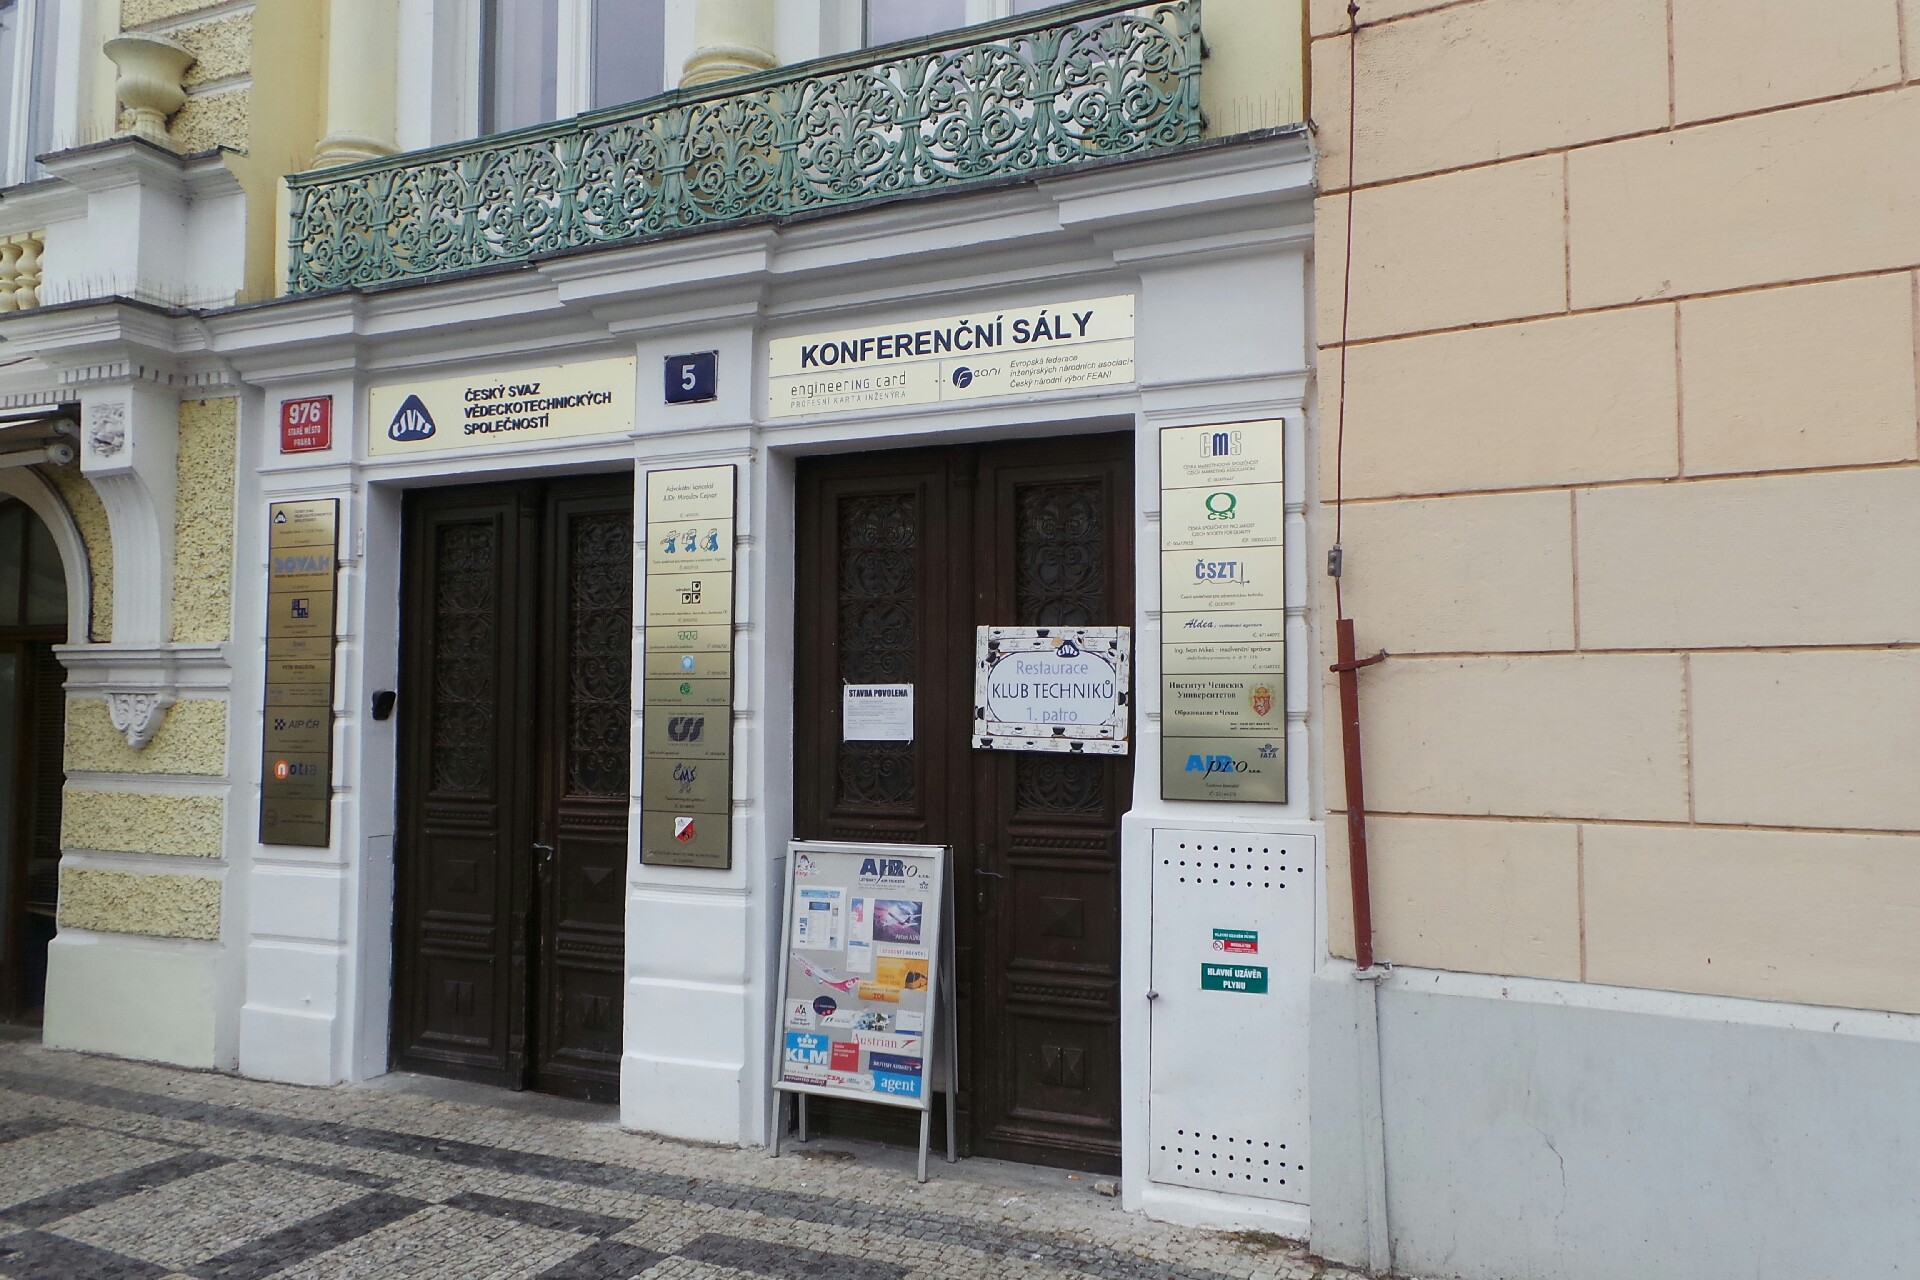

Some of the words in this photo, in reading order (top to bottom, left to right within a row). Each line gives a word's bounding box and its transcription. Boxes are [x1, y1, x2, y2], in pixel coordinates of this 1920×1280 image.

[802, 314, 1003, 368] KONFERENČNÍ
[1012, 310, 1094, 344] SÁLY
[682, 364, 695, 390] 5
[876, 371, 906, 388] card
[464, 386, 505, 402] ČESKÝ
[508, 383, 540, 398] SVAZ
[833, 395, 862, 404] KARTA
[865, 390, 906, 401] INŽENÝRA
[464, 391, 612, 419] VĚDECKOTECHNICKÝCH
[289, 402, 320, 424] 976
[464, 413, 549, 436] SPOLEČNOSTÍ
[293, 438, 311, 447] PRAHA
[1195, 558, 1237, 580] ČSZT
[1250, 646, 1271, 654] správce
[1016, 660, 1088, 675] Restaurace
[992, 683, 1029, 699] KLUB
[1033, 680, 1114, 699] TECHNIKŮ
[1169, 682, 1206, 690] Институт
[1208, 681, 1244, 689] Чешских
[848, 689, 873, 698] STAVBA
[874, 689, 908, 698] POVOLENA
[1177, 692, 1236, 700] Университетов
[1026, 707, 1037, 721] 1.
[1042, 707, 1078, 724] patro
[1174, 709, 1213, 717] Образование
[1207, 967, 1233, 978] HLAVNÍ
[1234, 968, 1262, 979] UZÁVĚR
[1223, 980, 1246, 990] PLYNU
[852, 1033, 897, 1048] Austrian
[785, 1048, 828, 1065] KLM
[873, 1060, 891, 1068] BRITISH
[881, 1077, 915, 1092] agent
